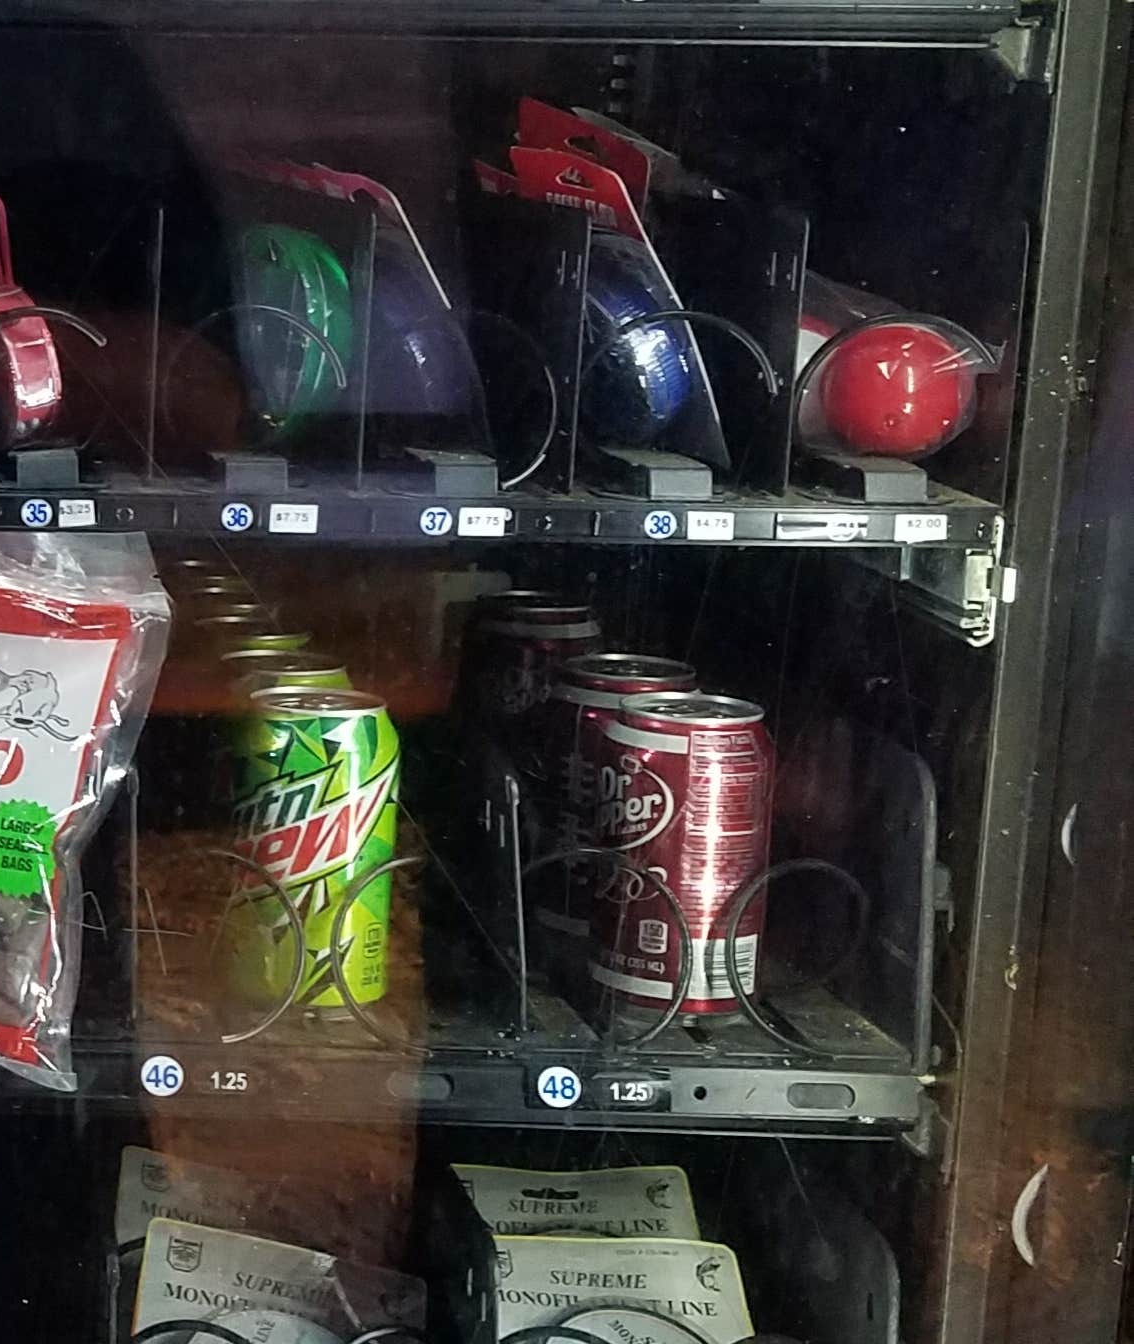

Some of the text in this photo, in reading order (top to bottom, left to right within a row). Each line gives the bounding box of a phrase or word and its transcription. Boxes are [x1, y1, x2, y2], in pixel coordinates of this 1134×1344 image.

[26, 503, 47, 523] 35
[227, 508, 309, 527] 36 $7.75
[425, 512, 446, 531] 37
[649, 515, 672, 535] 38
[601, 767, 632, 800] Dr
[1, 856, 34, 872] BAGS
[146, 1066, 248, 1090] 46 1.25
[543, 1076, 648, 1101] 48 1.25
[550, 1269, 647, 1290] SUPREME
[667, 1299, 718, 1317] LINE
